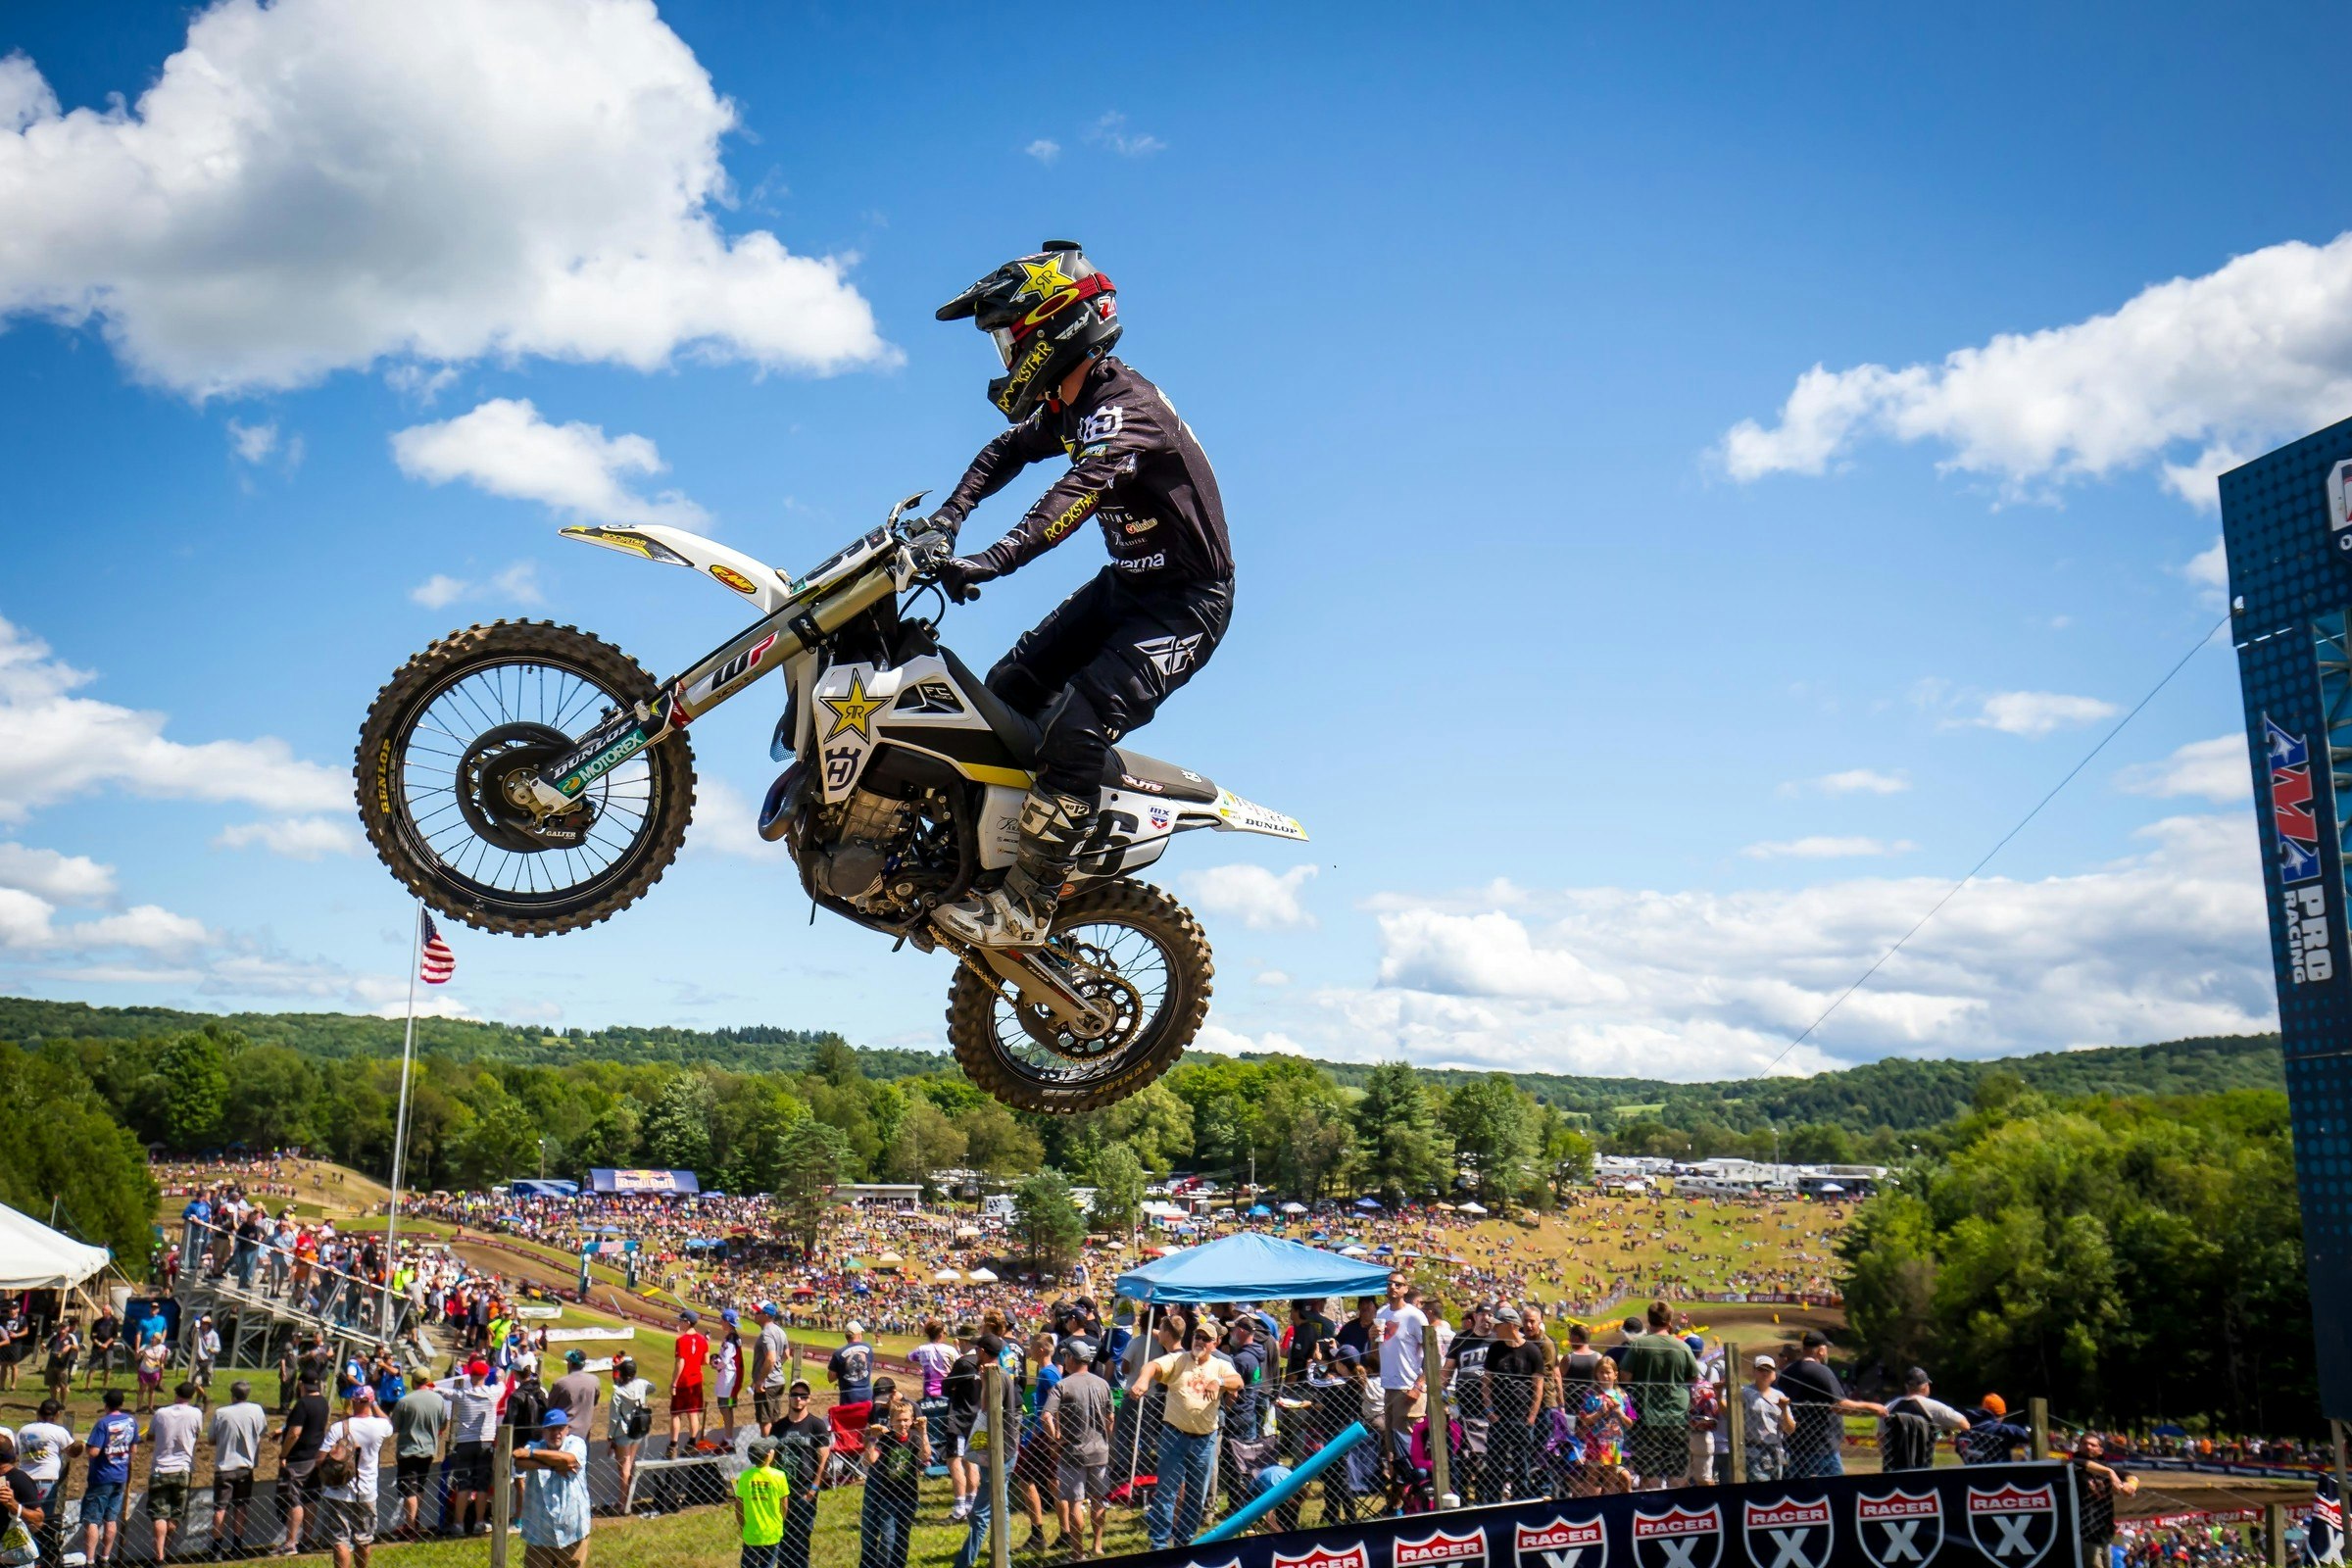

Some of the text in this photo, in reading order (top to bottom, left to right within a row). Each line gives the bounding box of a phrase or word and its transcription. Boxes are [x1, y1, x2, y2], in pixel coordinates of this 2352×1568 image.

[711, 633, 776, 691] WP
[554, 719, 632, 780] DUNLOP
[578, 732, 643, 782] MOTOREX
[1122, 774, 1163, 792] GUTS
[2263, 710, 2323, 884] AMA
[1246, 818, 1298, 834] DUNLOP
[2282, 889, 2307, 985] RACING
[2298, 884, 2334, 983] PRO
[1094, 1059, 1152, 1095] DUNLOP
[1751, 1508, 1825, 1524] RACER
[1862, 1500, 1934, 1515] RACER
[1973, 1496, 2046, 1510] RACER
[1521, 1529, 1597, 1546] RACER
[1639, 1517, 1713, 1535] RACER
[1881, 1520, 1924, 1563] X
[1992, 1515, 2036, 1557] X
[1400, 1542, 1479, 1561] RACER
[1657, 1537, 1699, 1568] X
[1768, 1528, 1816, 1568] X
